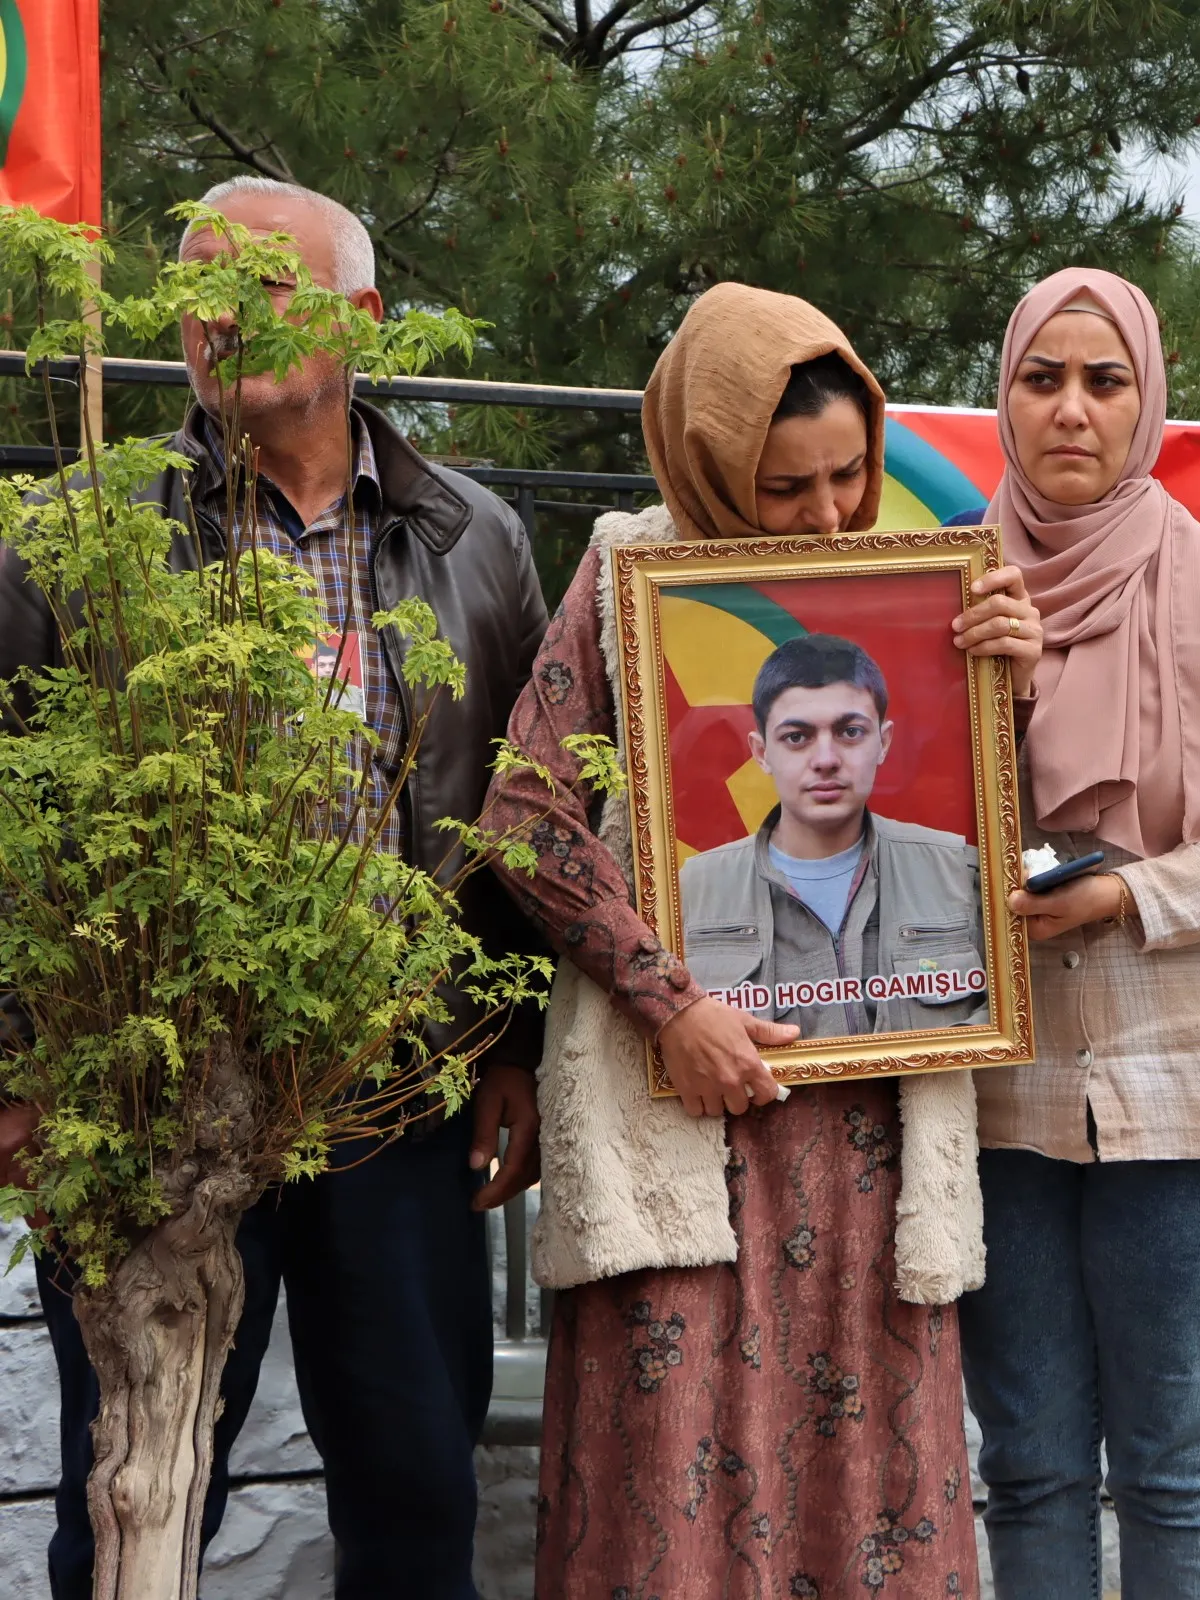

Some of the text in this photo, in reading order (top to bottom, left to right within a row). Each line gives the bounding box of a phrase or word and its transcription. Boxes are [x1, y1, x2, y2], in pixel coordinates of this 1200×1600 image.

[707, 969, 987, 1010] EHÎD HOGIR QAMIŞLO
